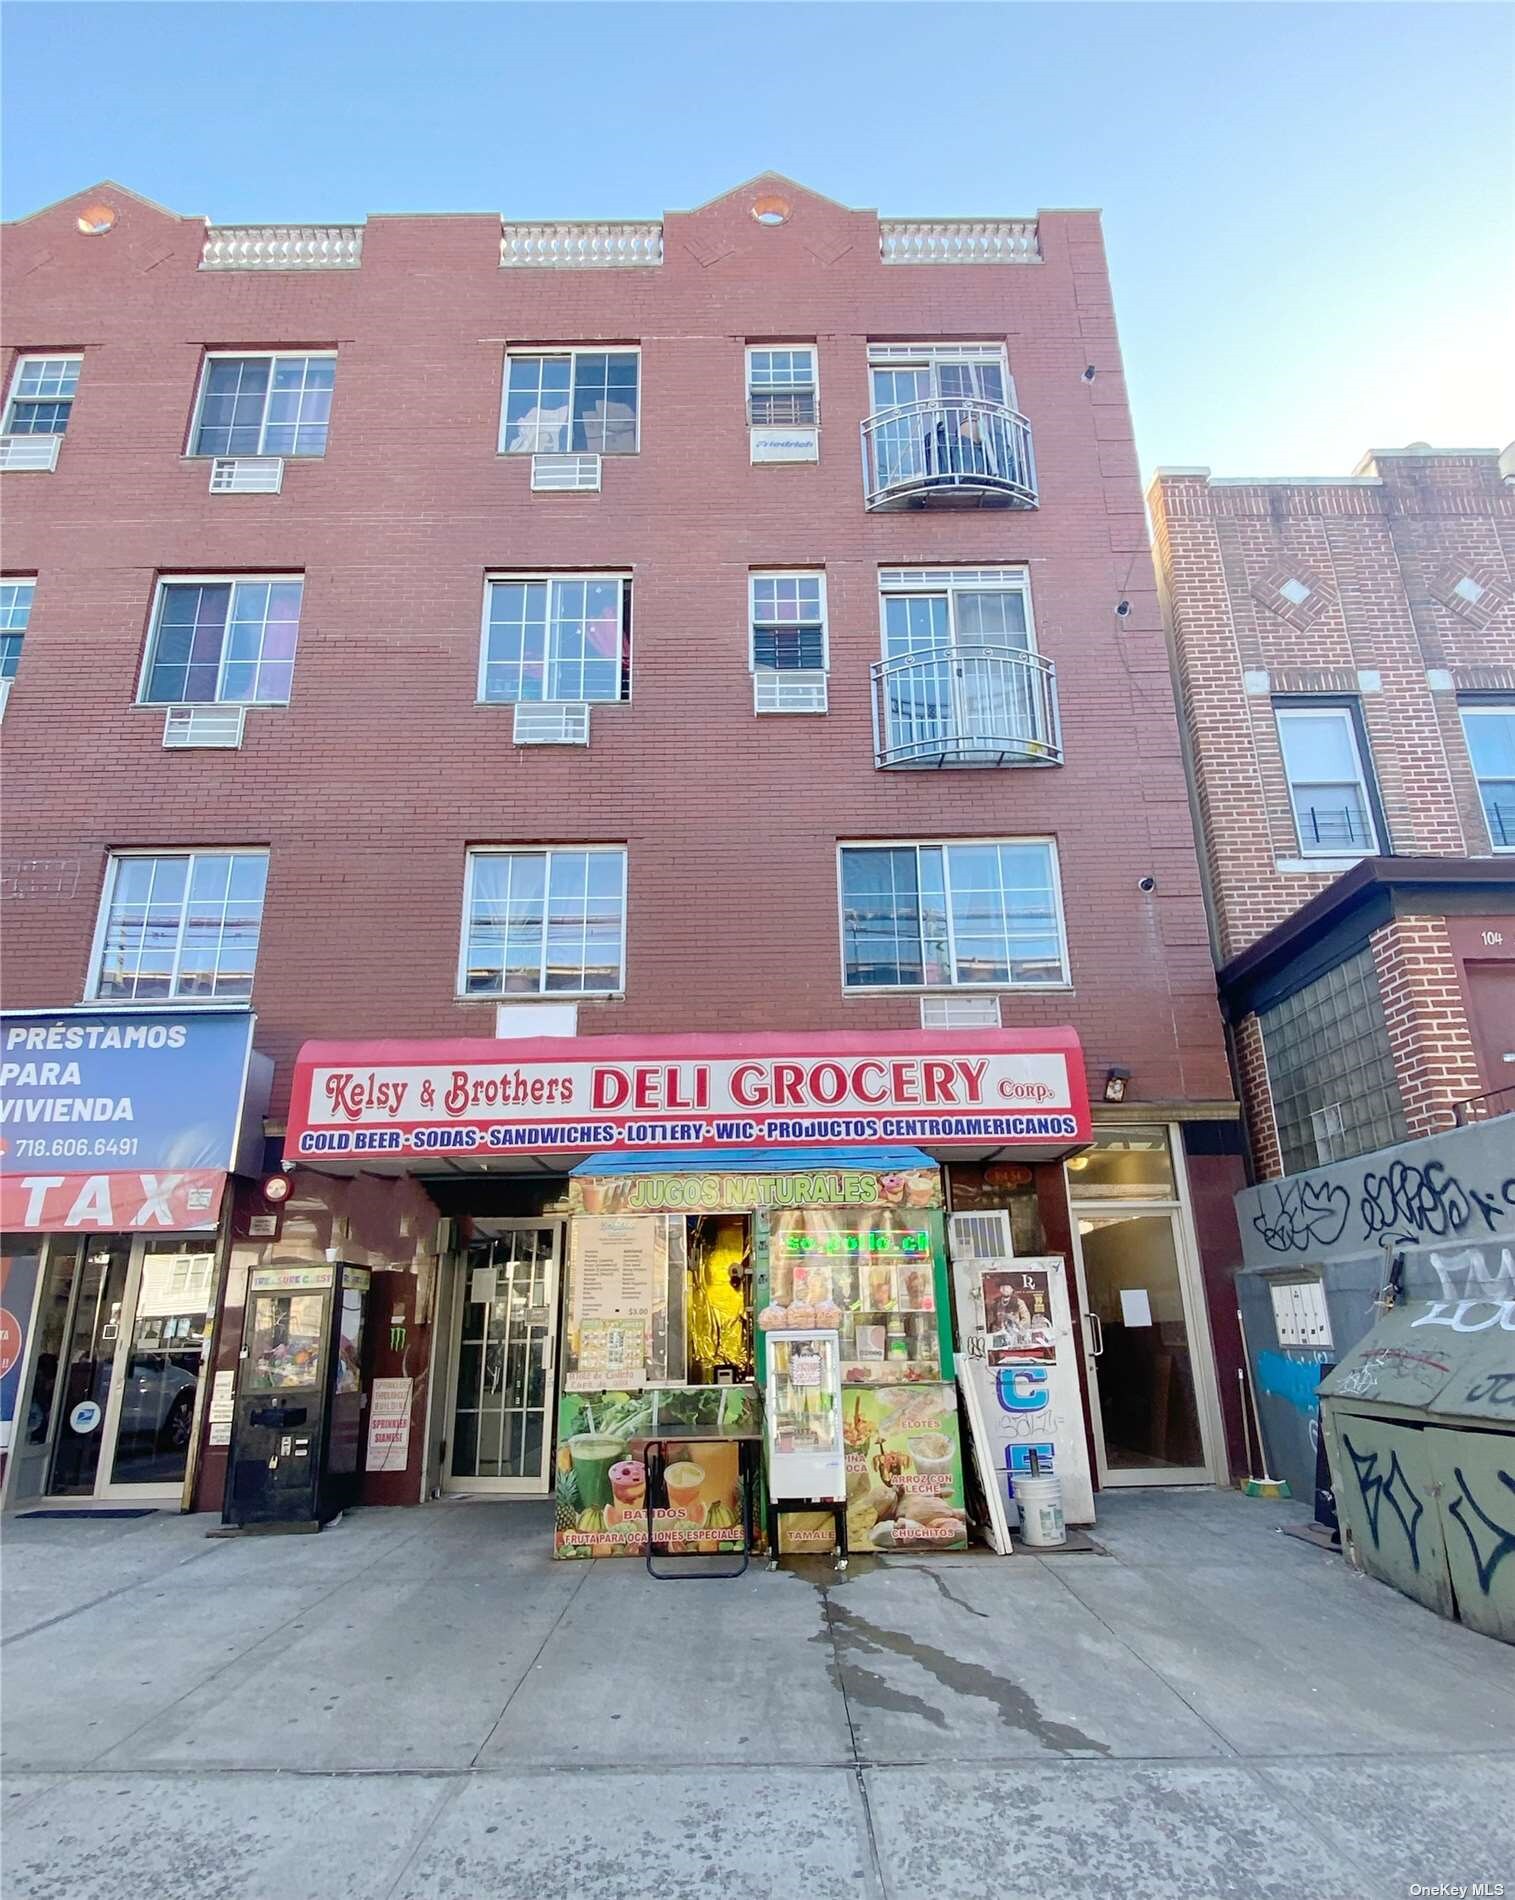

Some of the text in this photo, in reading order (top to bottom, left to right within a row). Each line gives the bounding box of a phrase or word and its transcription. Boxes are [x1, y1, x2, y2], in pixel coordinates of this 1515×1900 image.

[1481, 931, 1503, 945] 104
[6, 1022, 187, 1050] PRÉSTAMOS
[0, 1062, 81, 1086] PARA
[325, 1072, 408, 1121] Kelsy
[420, 1079, 436, 1110] &
[444, 1068, 573, 1117] Brothers
[592, 1066, 709, 1111] DELI
[730, 1060, 988, 1108] GROCERY
[0, 1097, 134, 1123] VIVIENDA
[301, 1133, 350, 1150] COLD
[354, 1131, 400, 1149] BEER
[414, 1128, 476, 1148] SODAS
[489, 1124, 614, 1146] SANDWICHES
[716, 1122, 754, 1140] WIC
[882, 1117, 1075, 1137] CENTROAMERICANOS
[16, 1138, 138, 1157] 718.606.6491
[20, 1174, 185, 1227] TAX
[630, 1175, 878, 1207] JUGOS NATURALES
[892, 1474, 953, 1484] ARROZ CON
[905, 1485, 939, 1493] LECHE
[565, 1533, 598, 1544] FRUTA
[600, 1532, 624, 1543] PARA
[628, 1530, 684, 1542] OCAIONES
[787, 1531, 836, 1540] TAMALE
[892, 1529, 954, 1538] CHUCHITOS
